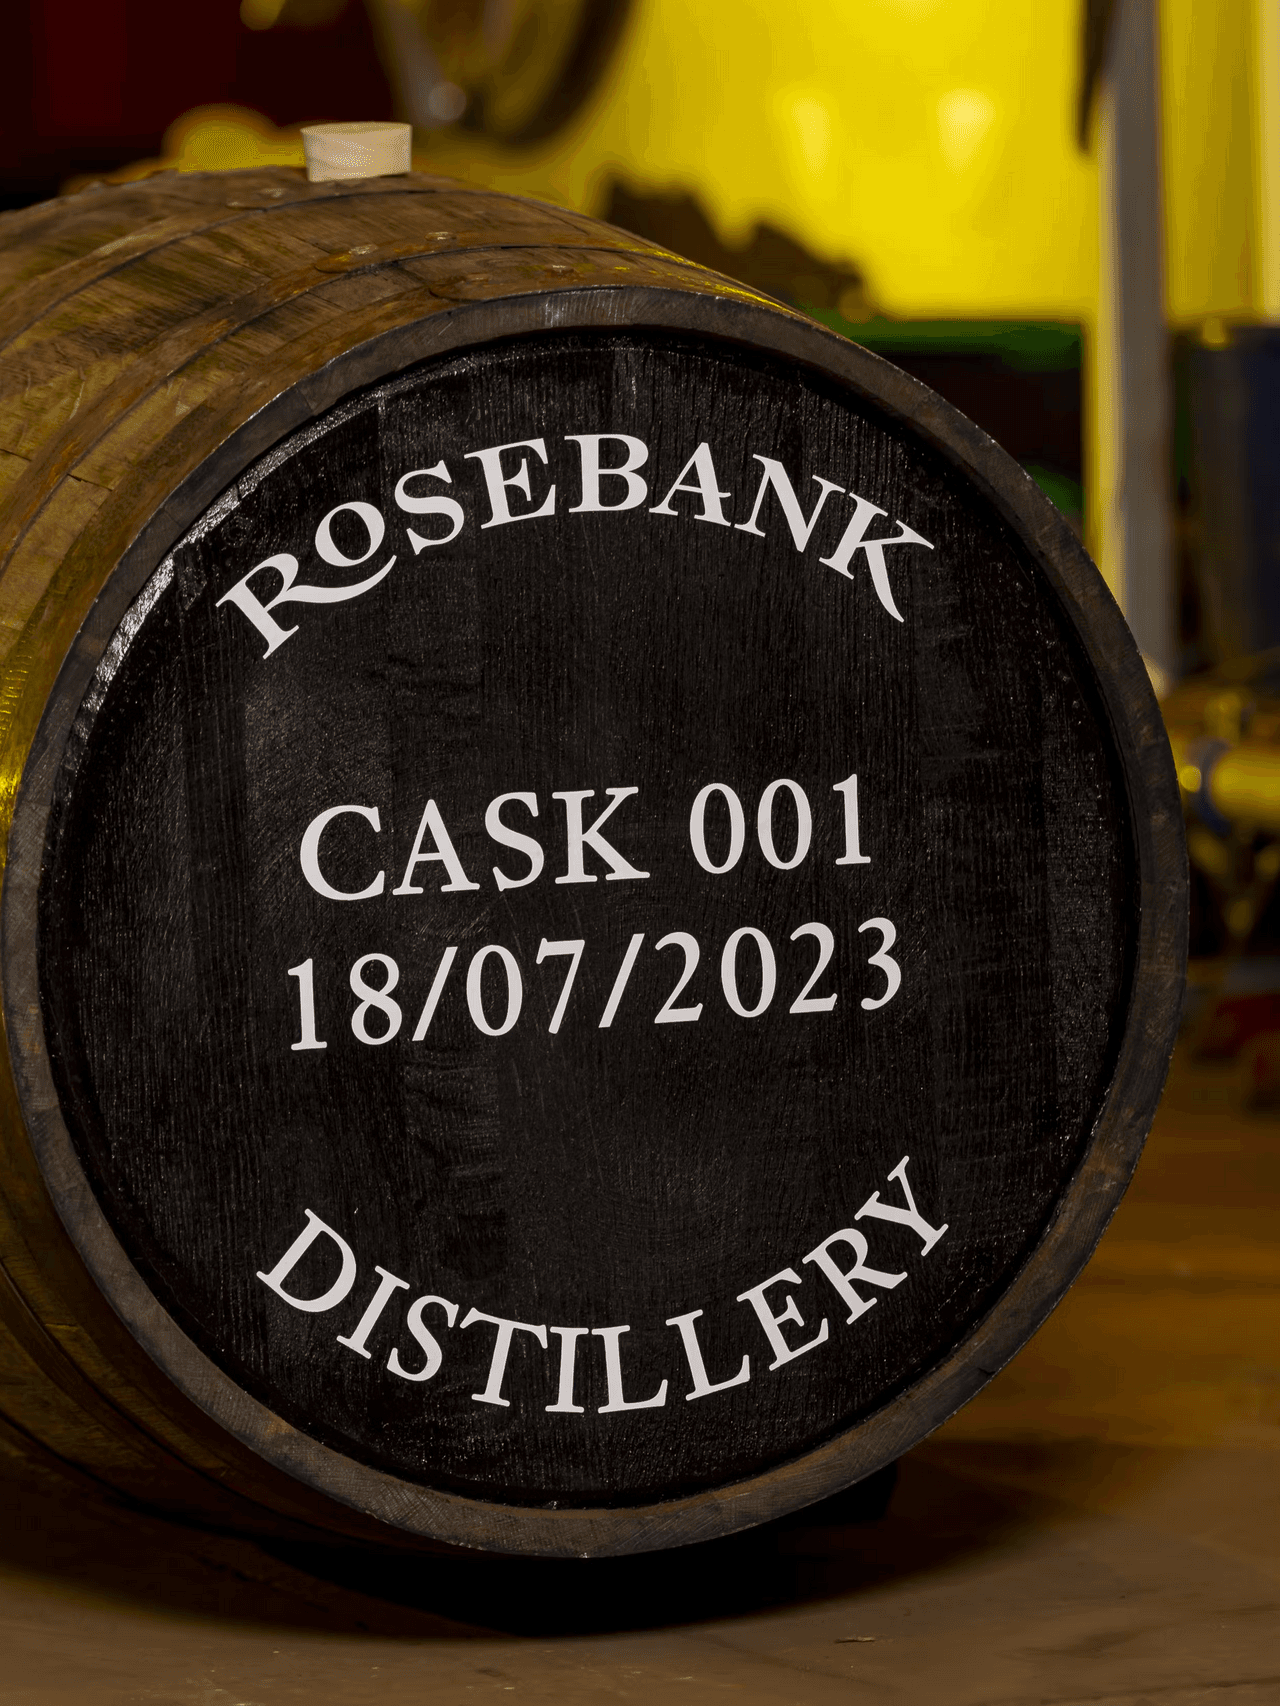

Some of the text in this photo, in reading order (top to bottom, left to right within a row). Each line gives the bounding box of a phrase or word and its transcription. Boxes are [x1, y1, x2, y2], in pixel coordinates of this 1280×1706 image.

[216, 433, 934, 660] ROSEBANK
[299, 773, 871, 901] CASK 001
[287, 917, 903, 1051] 18/07/2023
[256, 1155, 949, 1414] DISTILLERY
